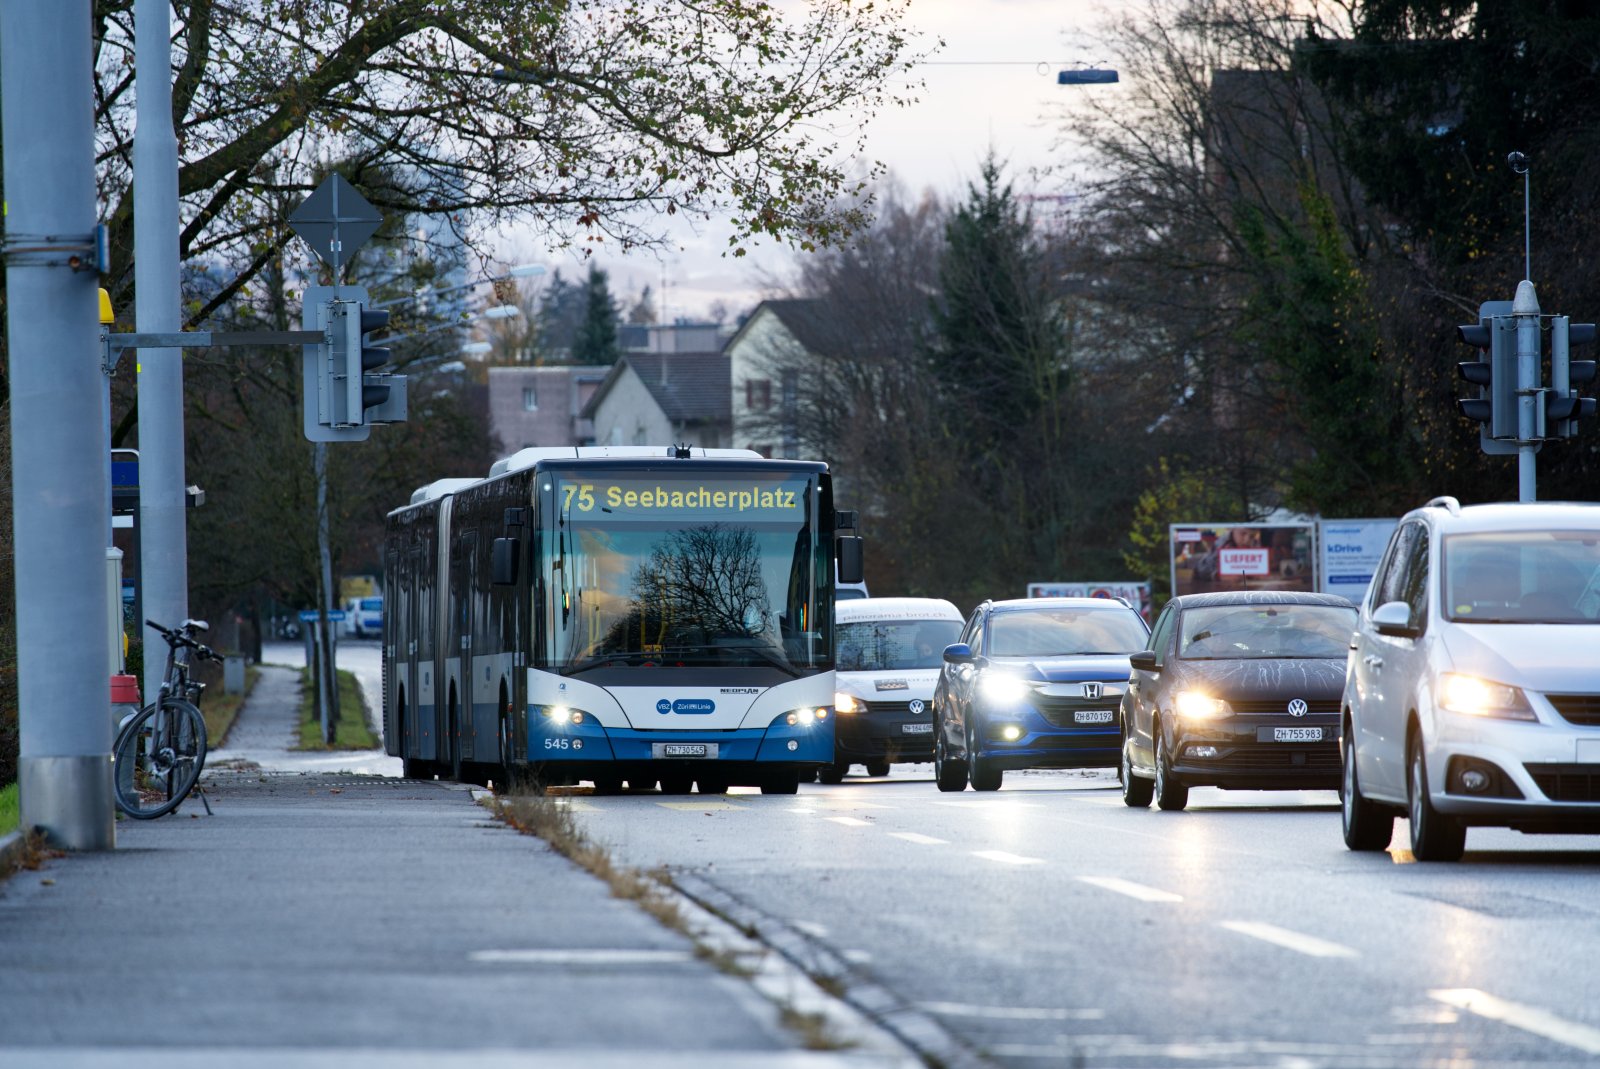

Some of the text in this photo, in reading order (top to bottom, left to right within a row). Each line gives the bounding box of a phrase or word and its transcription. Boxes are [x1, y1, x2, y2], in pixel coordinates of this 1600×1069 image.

[562, 485, 796, 511] 75 Seebacherplatz
[1327, 544, 1362, 553] kDrive
[1224, 554, 1263, 563] LIEFERT
[843, 612, 947, 622] panorama-brot.ch
[544, 738, 569, 749] 545
